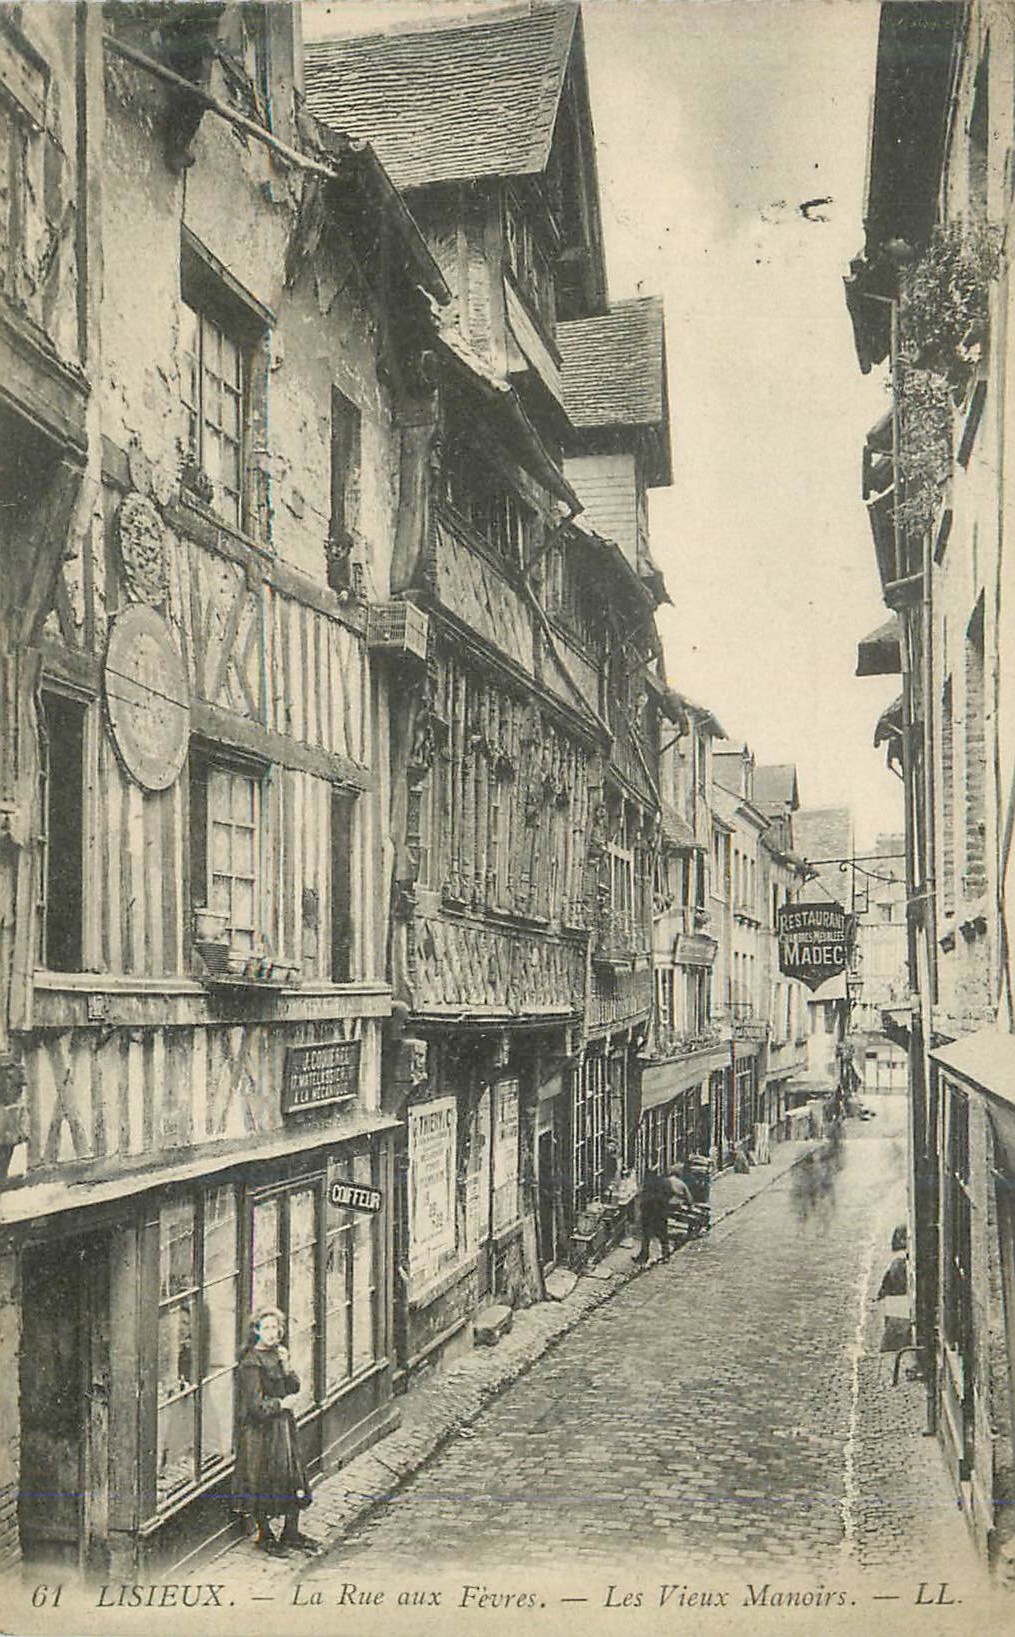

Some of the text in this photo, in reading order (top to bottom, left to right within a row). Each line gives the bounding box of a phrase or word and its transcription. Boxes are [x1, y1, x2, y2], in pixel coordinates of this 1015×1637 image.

[780, 910, 845, 934] RESTAURANT
[784, 944, 843, 966] MADEC
[332, 1184, 380, 1209] COIFFEUR
